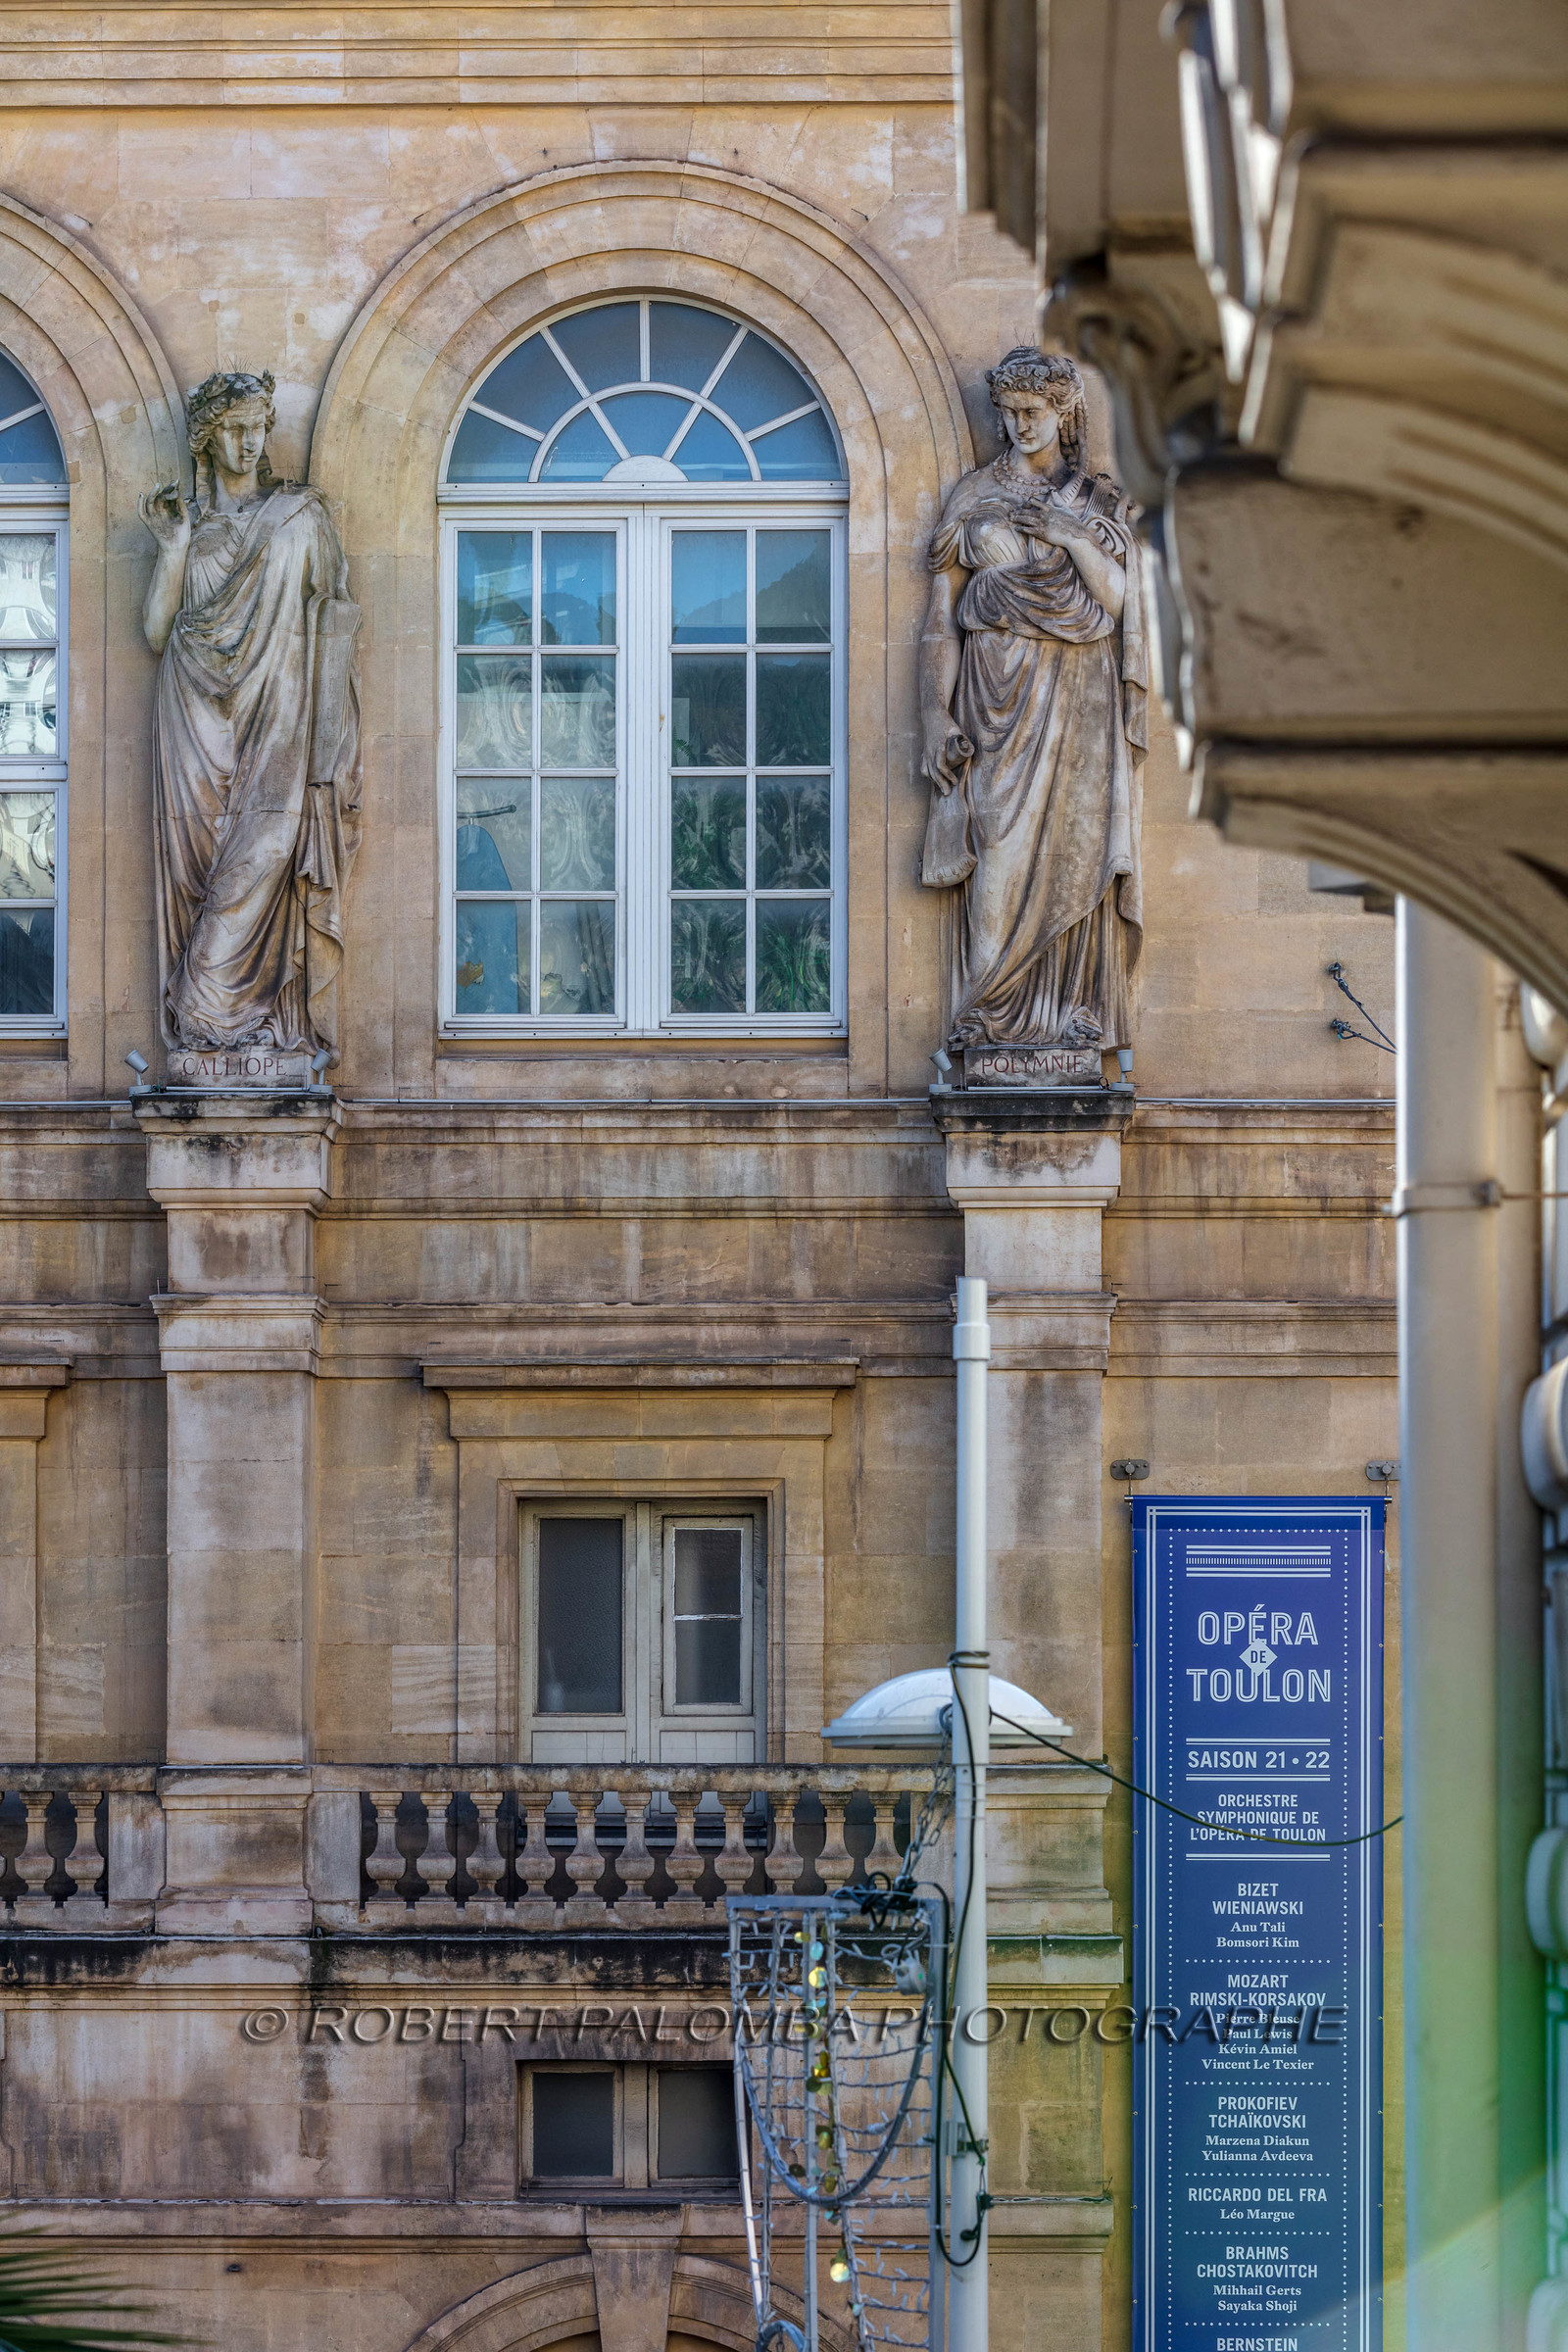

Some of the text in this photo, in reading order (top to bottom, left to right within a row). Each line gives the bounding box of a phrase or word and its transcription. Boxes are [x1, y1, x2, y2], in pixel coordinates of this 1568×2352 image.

[182, 1057, 286, 1076] CALLIOPE
[981, 1055, 1083, 1074] POLYMNIE
[1198, 1603, 1319, 1645] OPÉRA
[1250, 1650, 1267, 1665] DE
[1186, 1669, 1331, 1702] TOULON
[1188, 1751, 1256, 1768] SAISON
[1265, 1751, 1285, 1768] 21
[1305, 1751, 1330, 1768] 22
[1218, 1794, 1298, 1807] ORCHESTRE
[1197, 1810, 1319, 1826] SYMPHONIQUE DE
[1250, 1828, 1268, 1840] DE
[1272, 1828, 1326, 1841] TOULON
[1238, 1884, 1279, 1896] BIZET
[1212, 1901, 1302, 1915] WIENIAWSKI
[1231, 1922, 1286, 1932] Anu Tali
[1216, 1937, 1299, 1947] Bomsori Kim
[1228, 1975, 1289, 1987] MOZART
[1190, 1992, 1326, 2006] RIMSKI-KORSAKOV
[1216, 2013, 1300, 2024] Pierre Bleuse
[1223, 2029, 1293, 2039] Paul Lewis
[1218, 2043, 1298, 2054] Kévin Amiel
[1201, 2059, 1314, 2069] Vincent Le Texier
[1218, 2096, 1298, 2110] PROKOFIEV
[1208, 2112, 1305, 2128] TCHAÏKOVSKI
[1204, 2134, 1310, 2146] Marzena Diakun
[1201, 2150, 1313, 2161] Yulianna Avdeeva
[1189, 2188, 1327, 2201] RICCARDO DEL FRA
[1220, 2209, 1295, 2223] Léo Margue
[1226, 2246, 1289, 2260] BRAHMS
[1198, 2264, 1317, 2278] CHOSTAKOVITCH
[1213, 2284, 1301, 2295] Mihhail Gerts
[1218, 2300, 1297, 2314] Sayaka Shoji
[1216, 2337, 1298, 2352] BERNSTEIN
